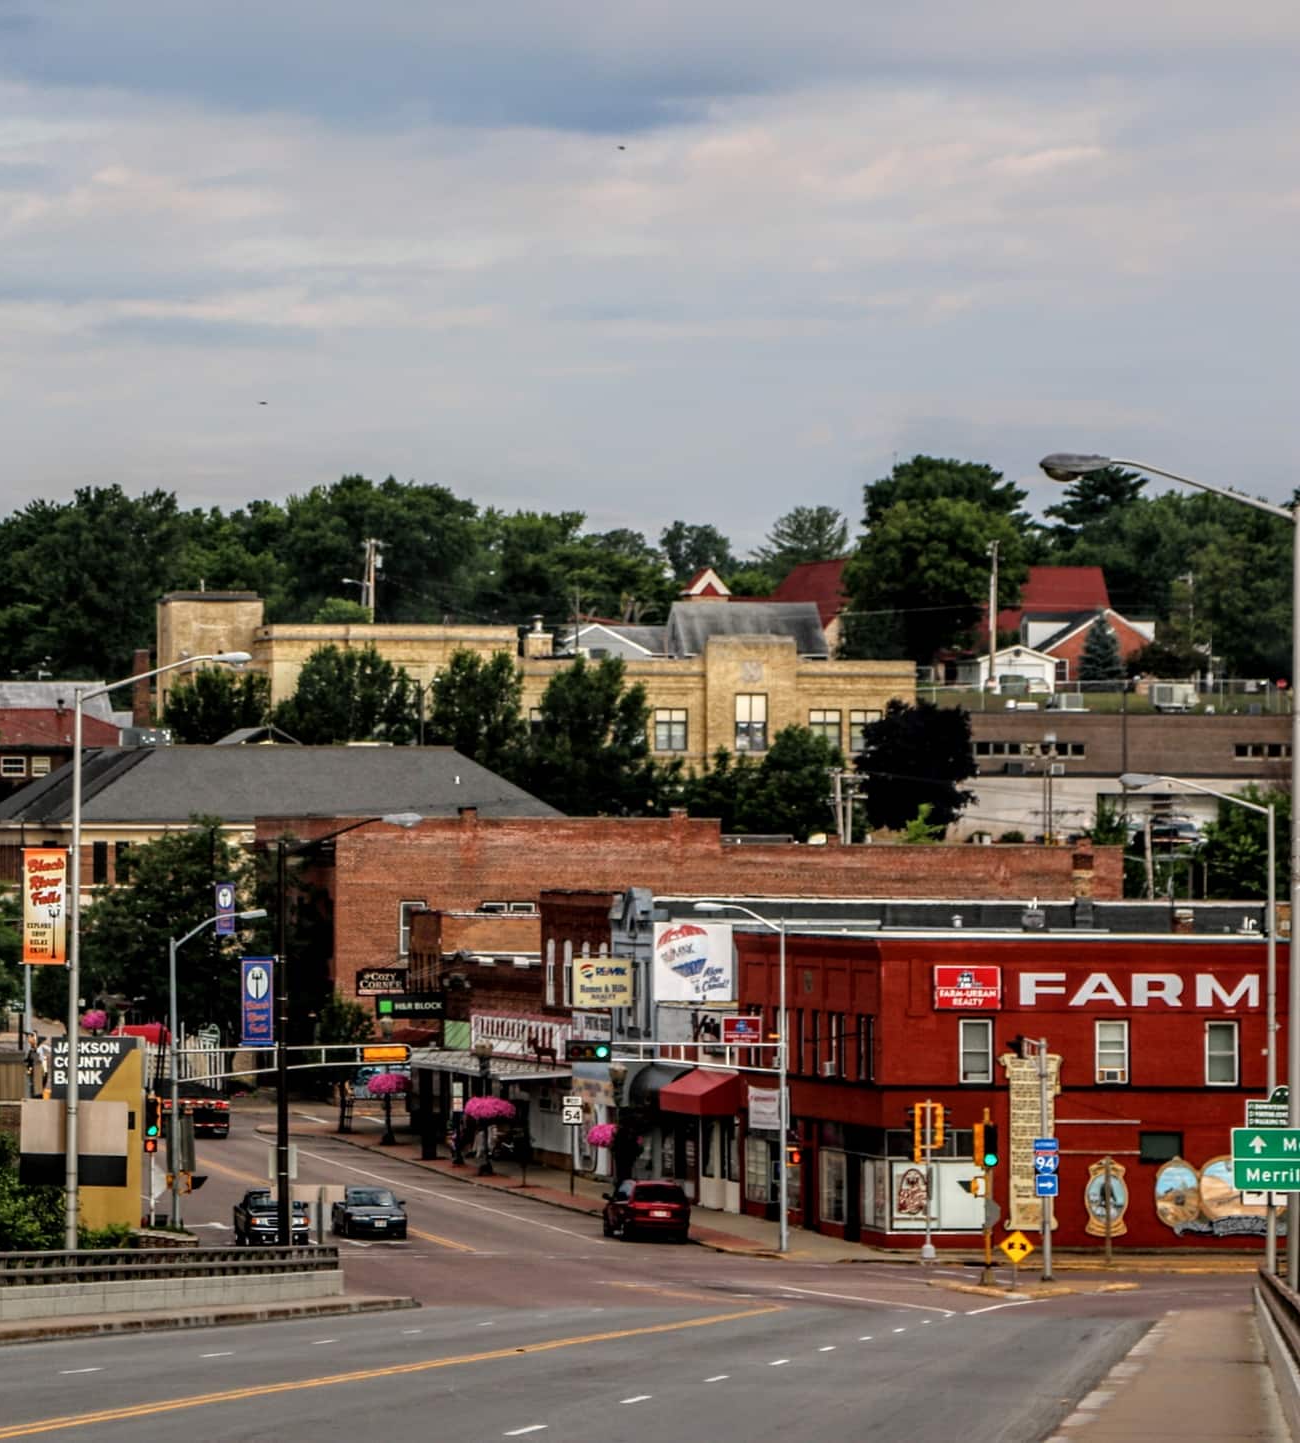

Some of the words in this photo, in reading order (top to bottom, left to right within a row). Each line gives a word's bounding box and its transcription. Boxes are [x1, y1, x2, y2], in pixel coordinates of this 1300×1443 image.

[27, 857, 64, 873] Black
[29, 875, 62, 891] River
[30, 891, 61, 907] Falls
[1019, 972, 1260, 1007] FARM
[414, 1002, 443, 1010] BLOCK
[54, 1070, 103, 1085] BNK
[565, 1110, 580, 1121] 54
[1283, 1138, 1300, 1152] M
[1036, 1156, 1055, 1169] 94
